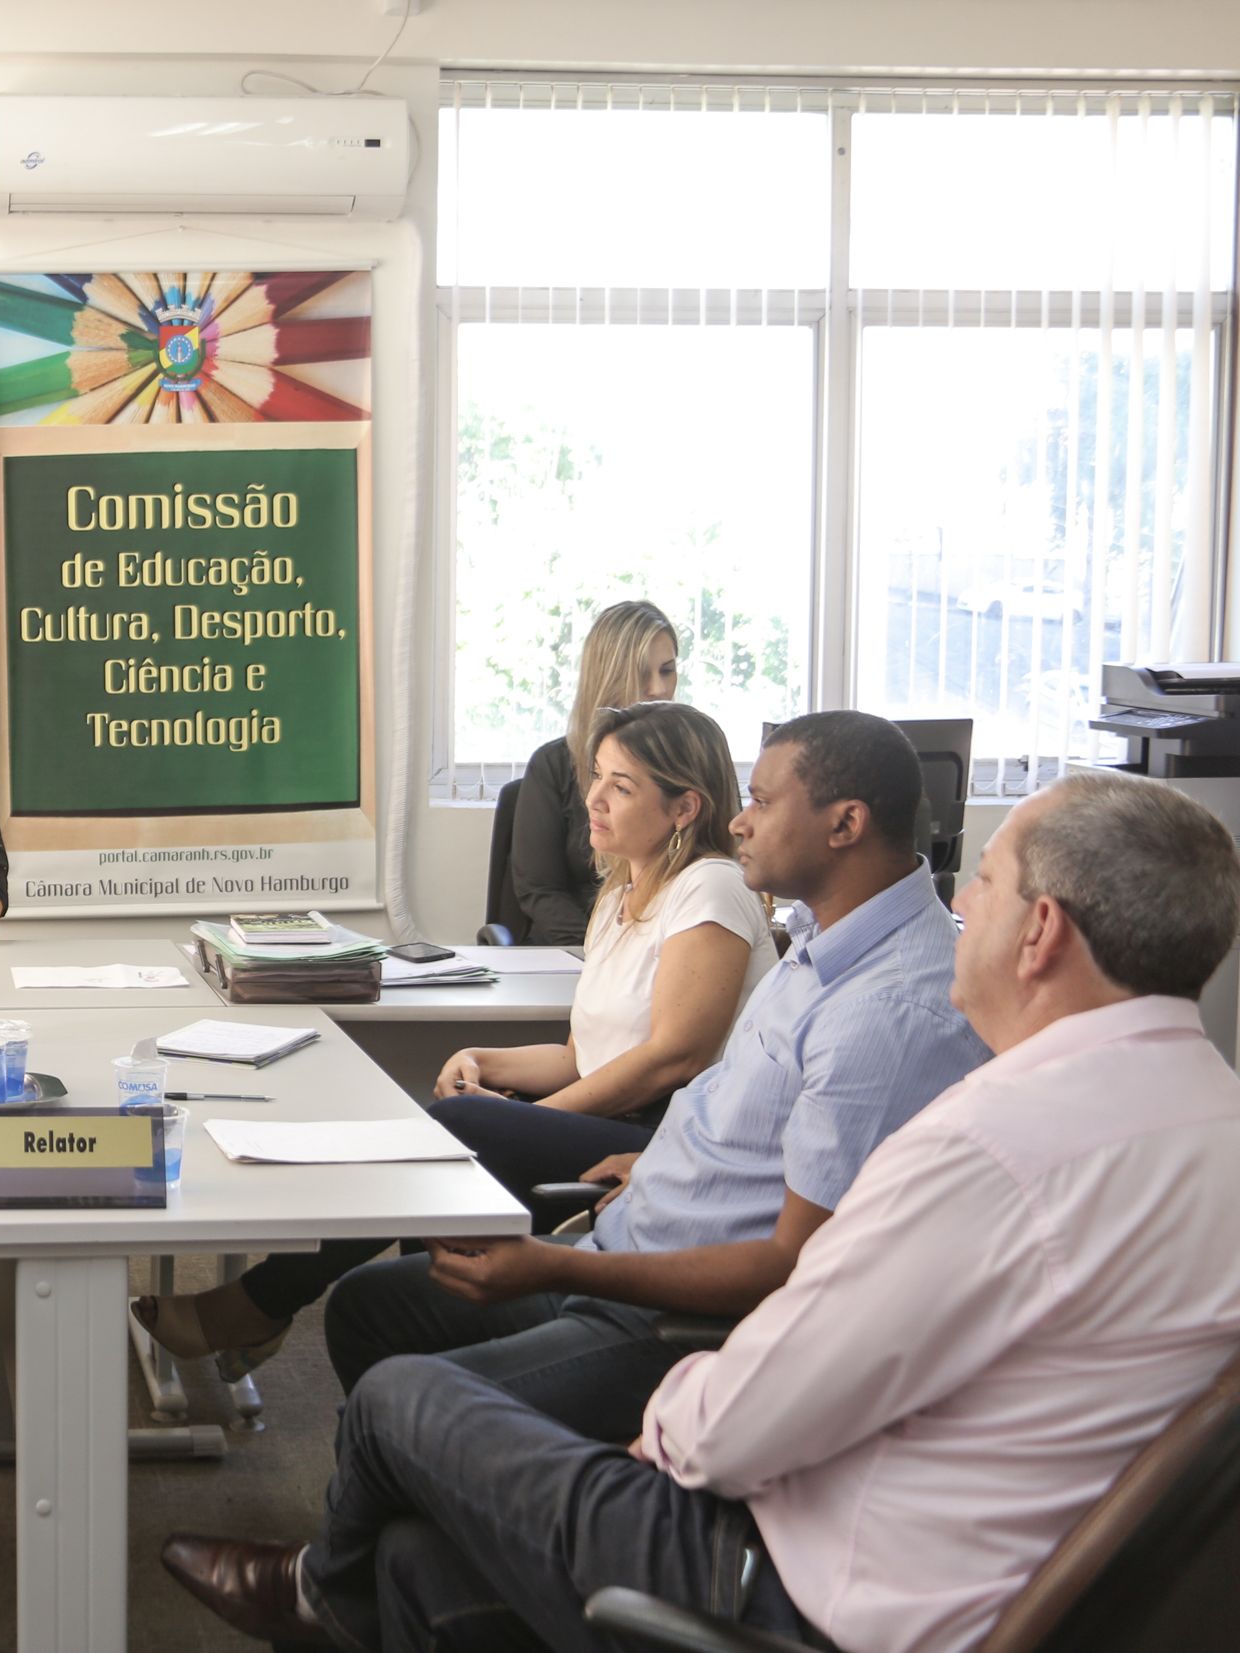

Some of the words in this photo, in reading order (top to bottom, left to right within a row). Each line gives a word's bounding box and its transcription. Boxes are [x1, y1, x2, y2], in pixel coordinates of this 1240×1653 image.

[67, 483, 299, 532] Comissão
[61, 552, 105, 589] de
[118, 550, 305, 597] Educação,
[20, 606, 160, 644] Cultura,
[173, 602, 347, 646] Desporto,
[104, 657, 233, 695] Ciência
[246, 663, 267, 692] e
[86, 709, 282, 753] Tecnologia
[98, 847, 275, 866] portal.camaranh.rs.gov.br
[25, 880, 93, 898] Câmara
[98, 877, 181, 899] Municipal
[185, 877, 207, 895] de
[212, 876, 255, 894] Novo
[260, 873, 351, 895] Hamburgo
[23, 1130, 97, 1153] Relator
